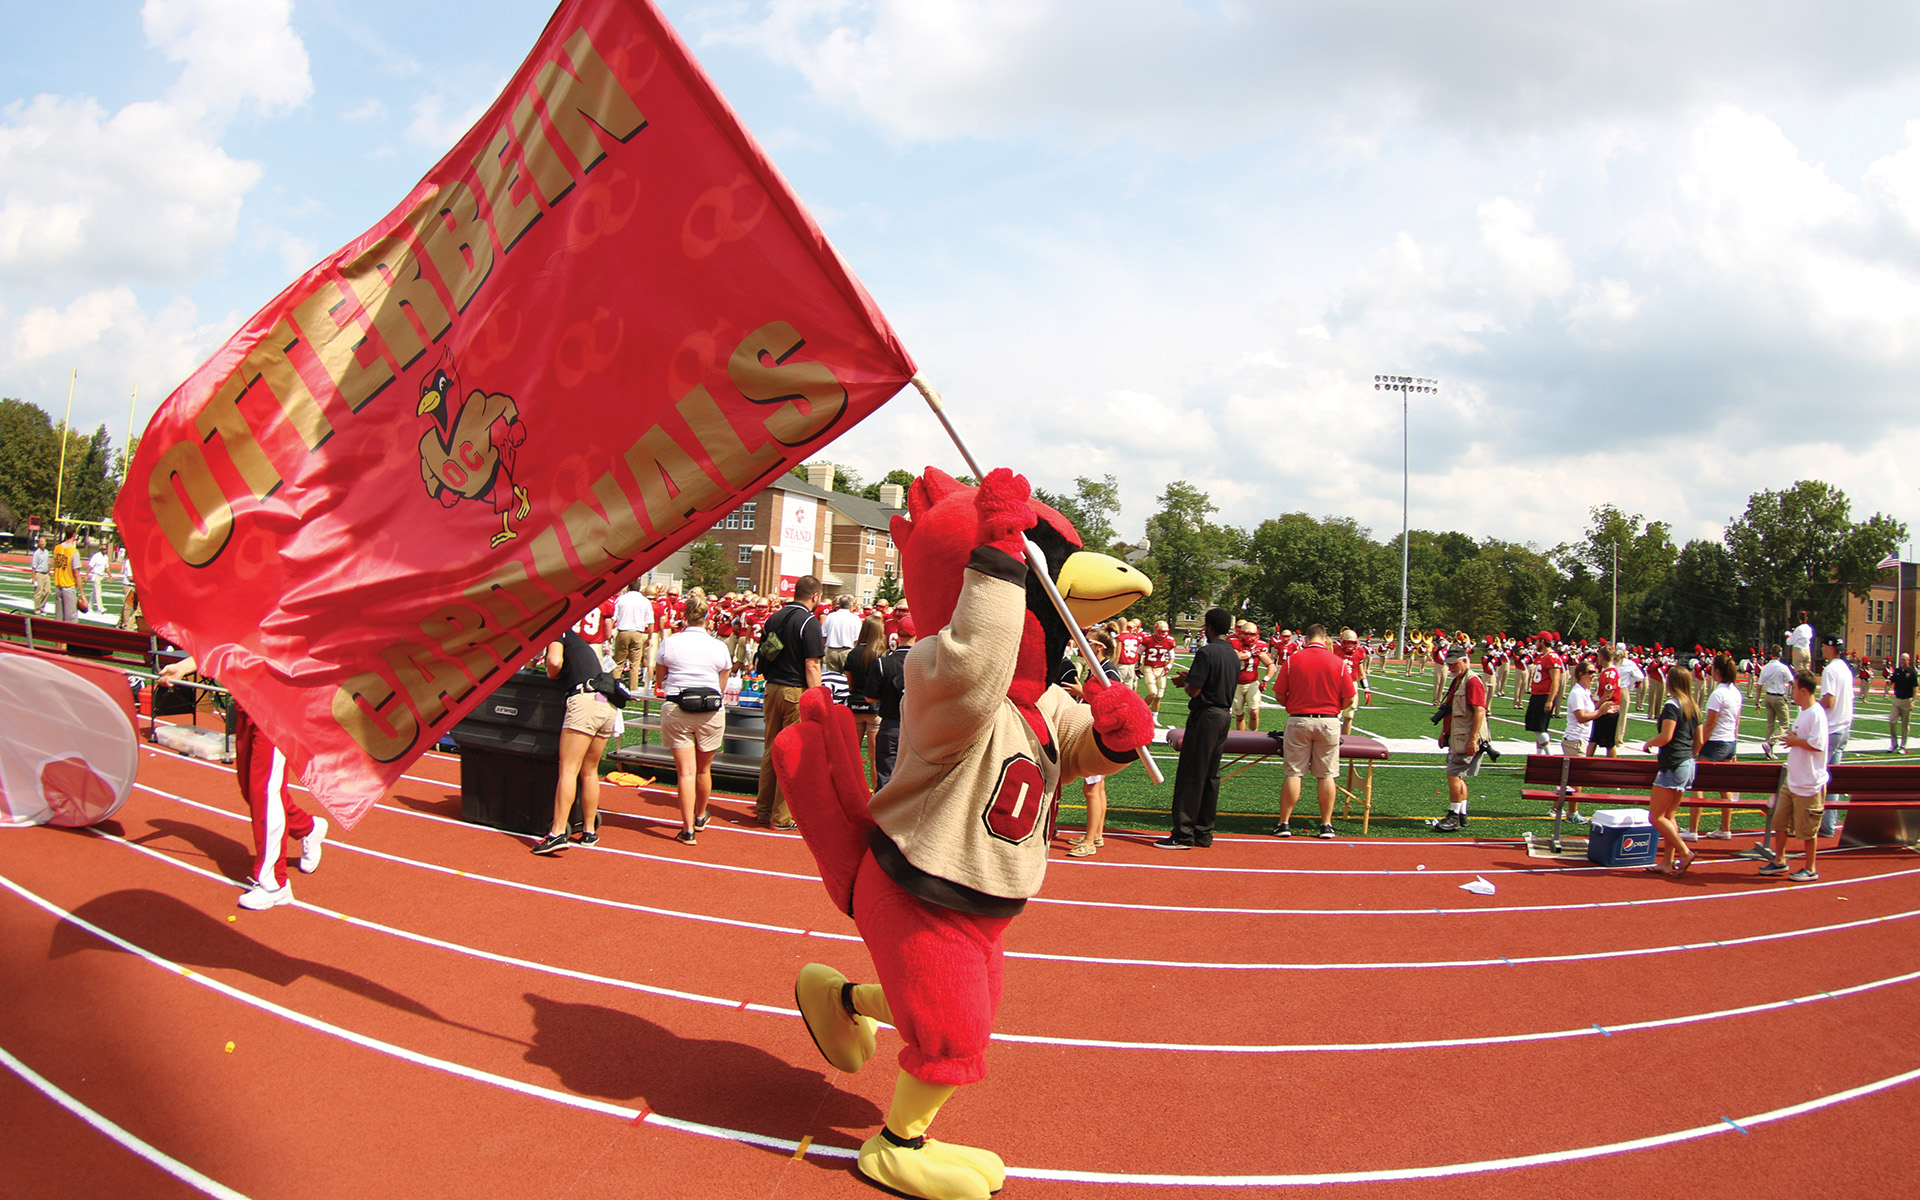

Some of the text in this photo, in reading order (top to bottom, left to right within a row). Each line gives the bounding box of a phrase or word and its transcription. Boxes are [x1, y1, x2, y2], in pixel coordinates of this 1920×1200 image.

[148, 25, 649, 568] OTTERBEIN
[441, 440, 485, 488] OC
[331, 320, 848, 763] CARDINALS
[784, 527, 812, 543] STAND
[1147, 647, 1168, 662] 27
[1604, 670, 1616, 679] 72
[496, 706, 515, 714] STANLEY
[1633, 840, 1649, 848] pepsi
